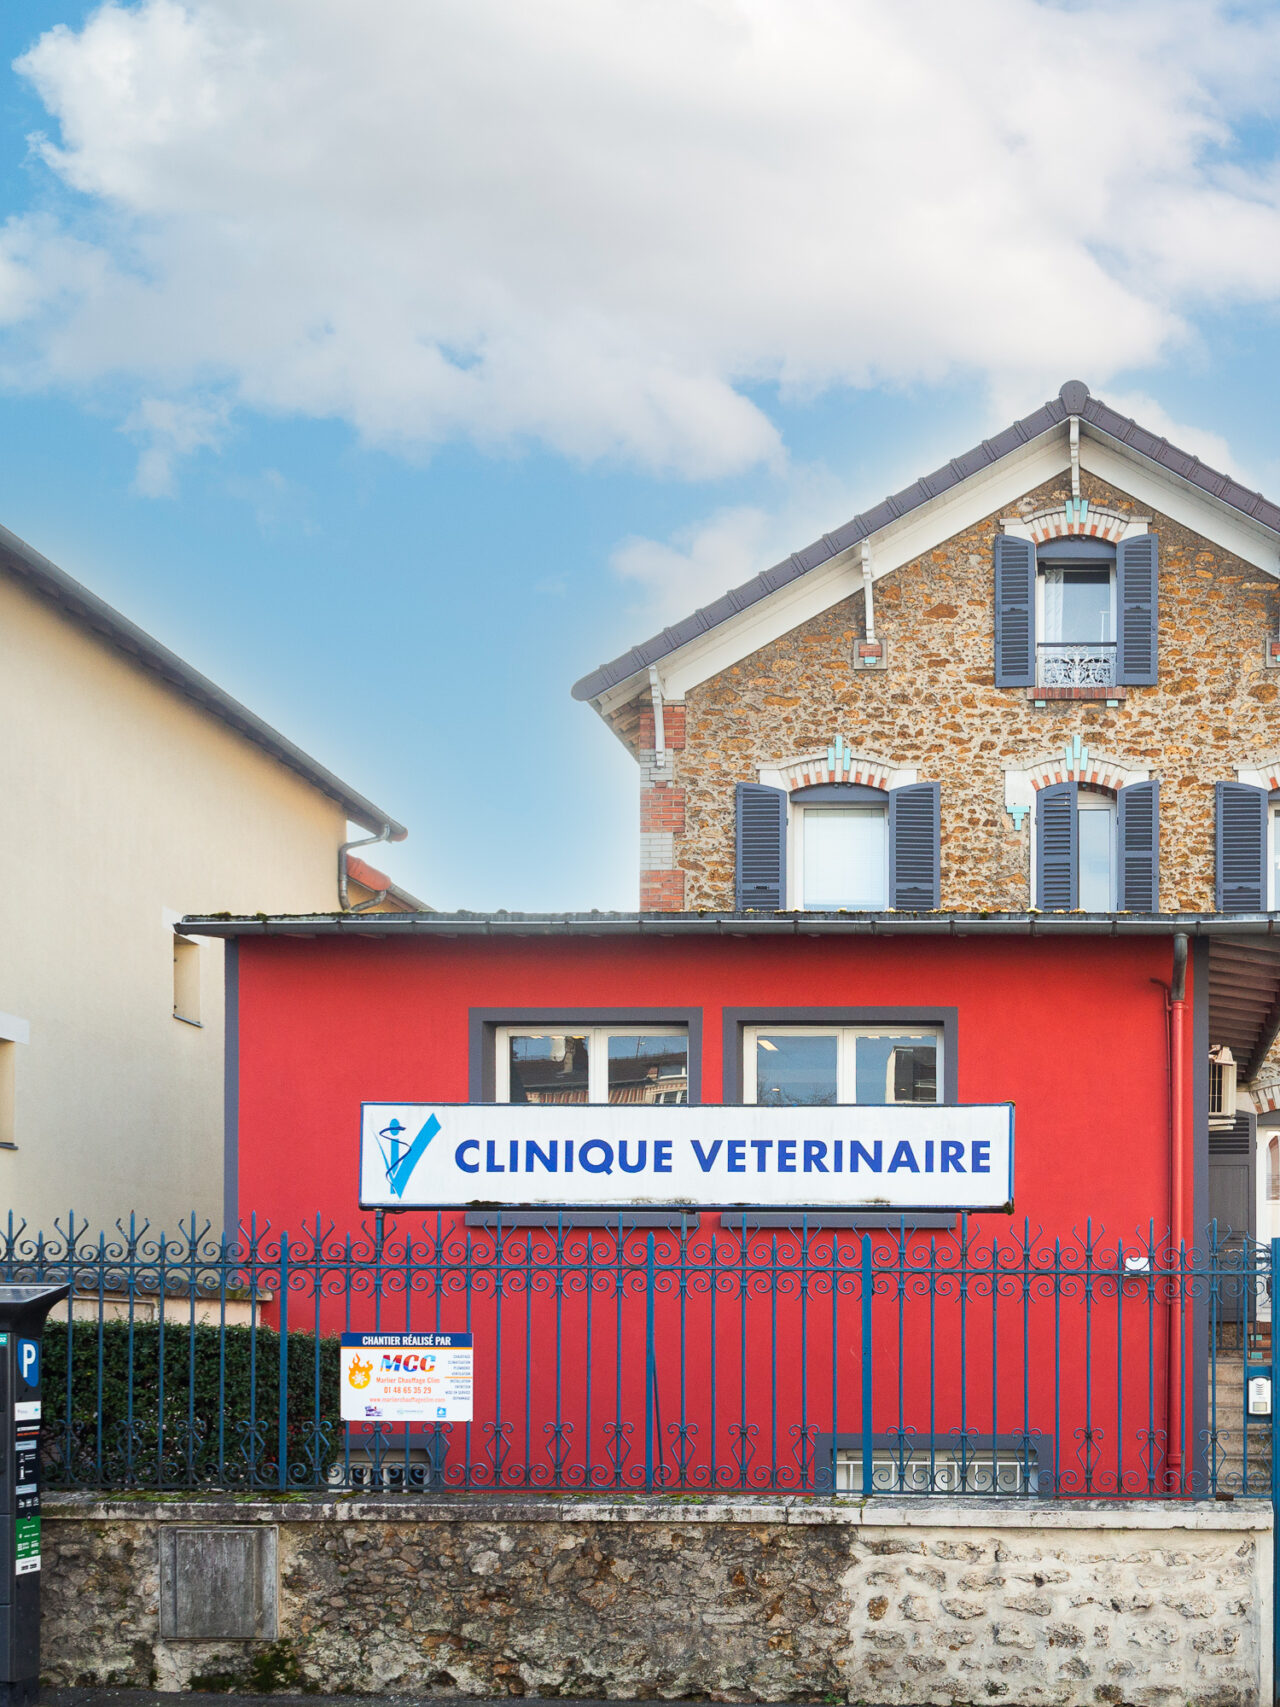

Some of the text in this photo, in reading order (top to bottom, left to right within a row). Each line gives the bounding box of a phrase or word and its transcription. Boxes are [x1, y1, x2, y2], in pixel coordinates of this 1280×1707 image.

[454, 1138, 991, 1176] CLINIQUE VETERINAIRE
[362, 1334, 451, 1346] CHANTIER RÉALISÉ PAR
[23, 1343, 36, 1378] P
[380, 1354, 437, 1373] MCC
